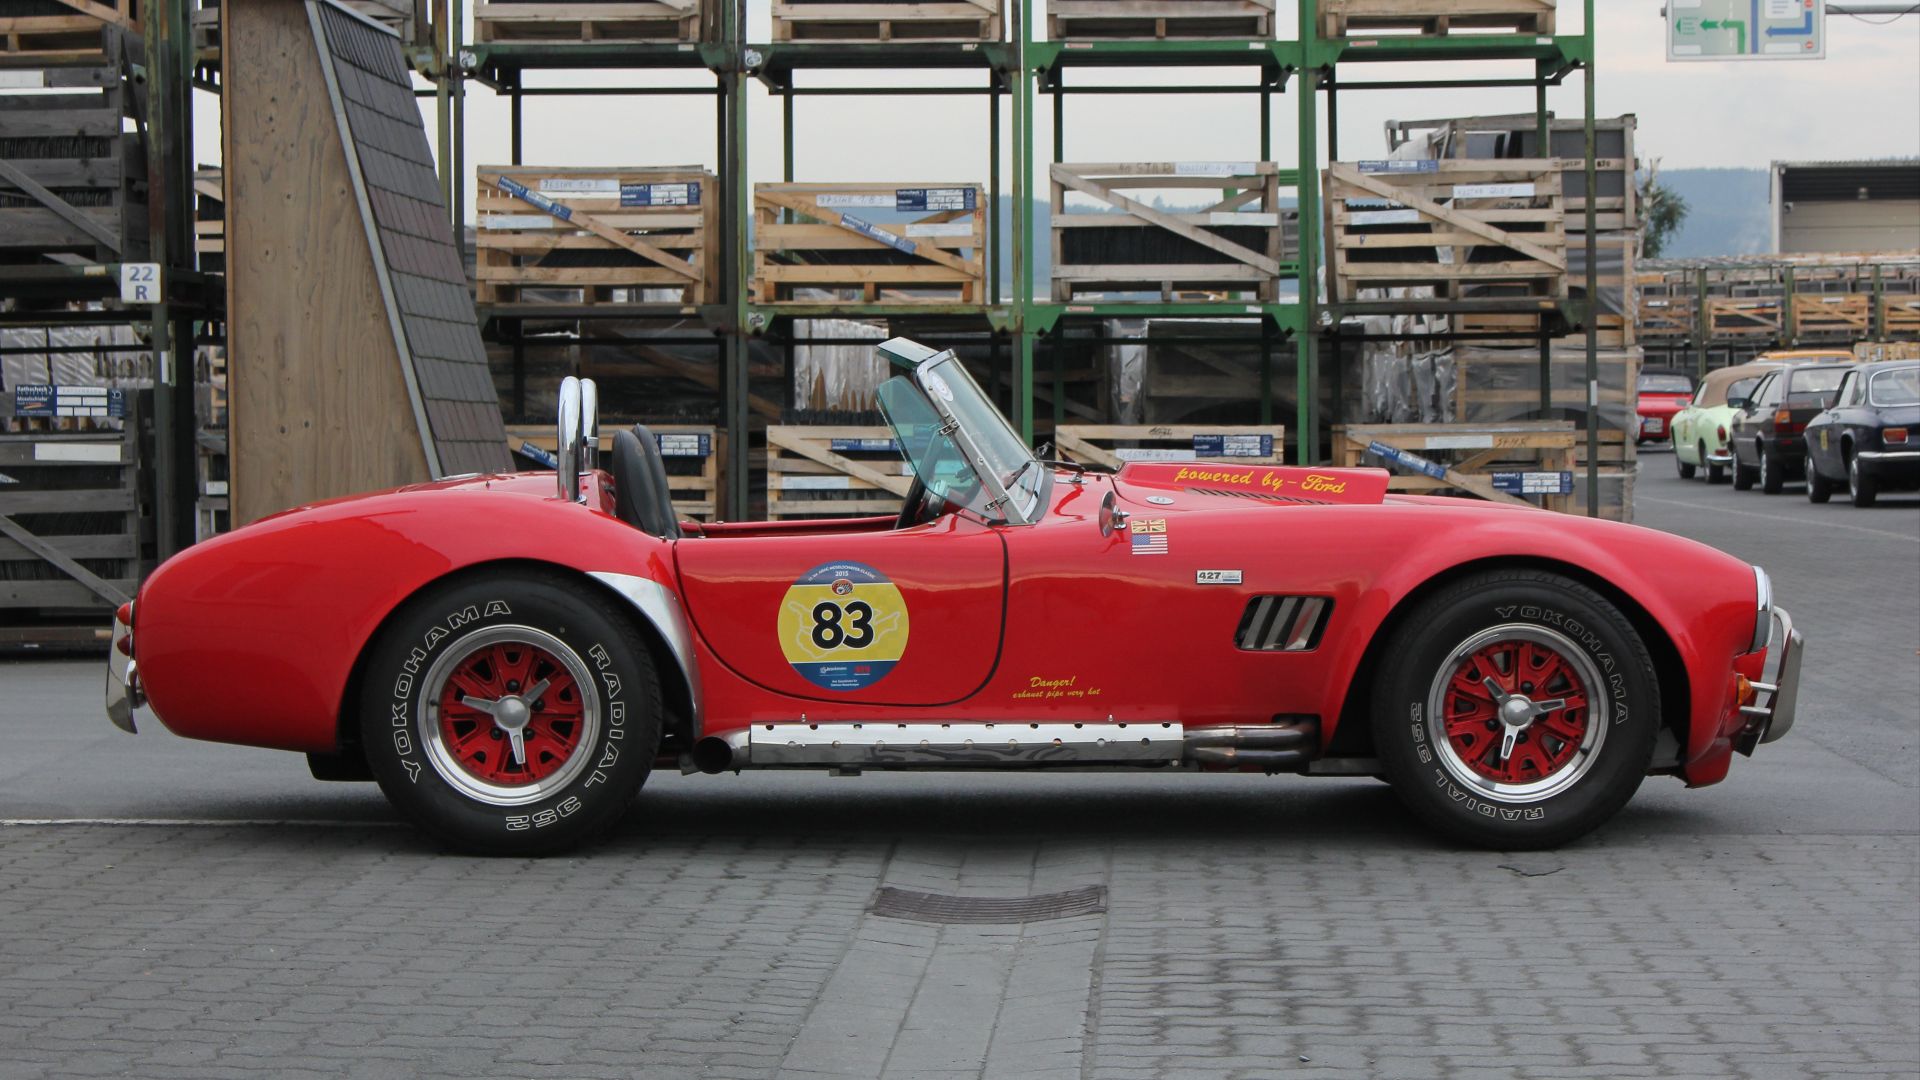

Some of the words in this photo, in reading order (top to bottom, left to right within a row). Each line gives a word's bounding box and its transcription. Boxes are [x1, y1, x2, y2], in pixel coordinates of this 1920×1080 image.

[129, 266, 153, 282] 22
[135, 285, 148, 300] R
[1174, 467, 1254, 485] powered
[1261, 471, 1284, 491] by
[1301, 474, 1346, 494] Ford
[1198, 571, 1221, 580] 427
[811, 601, 875, 650] 83
[1495, 605, 1628, 724] YOKOHAMA
[392, 600, 512, 783] YOKOHAMA
[1030, 676, 1076, 689] Danger!
[1045, 690, 1064, 699] pipe
[1067, 689, 1084, 698] very
[1087, 686, 1101, 695] hot
[584, 644, 625, 788] RADIAL
[1410, 702, 1432, 764] 352
[1435, 768, 1544, 821] RADIAL
[505, 796, 581, 831] 352
